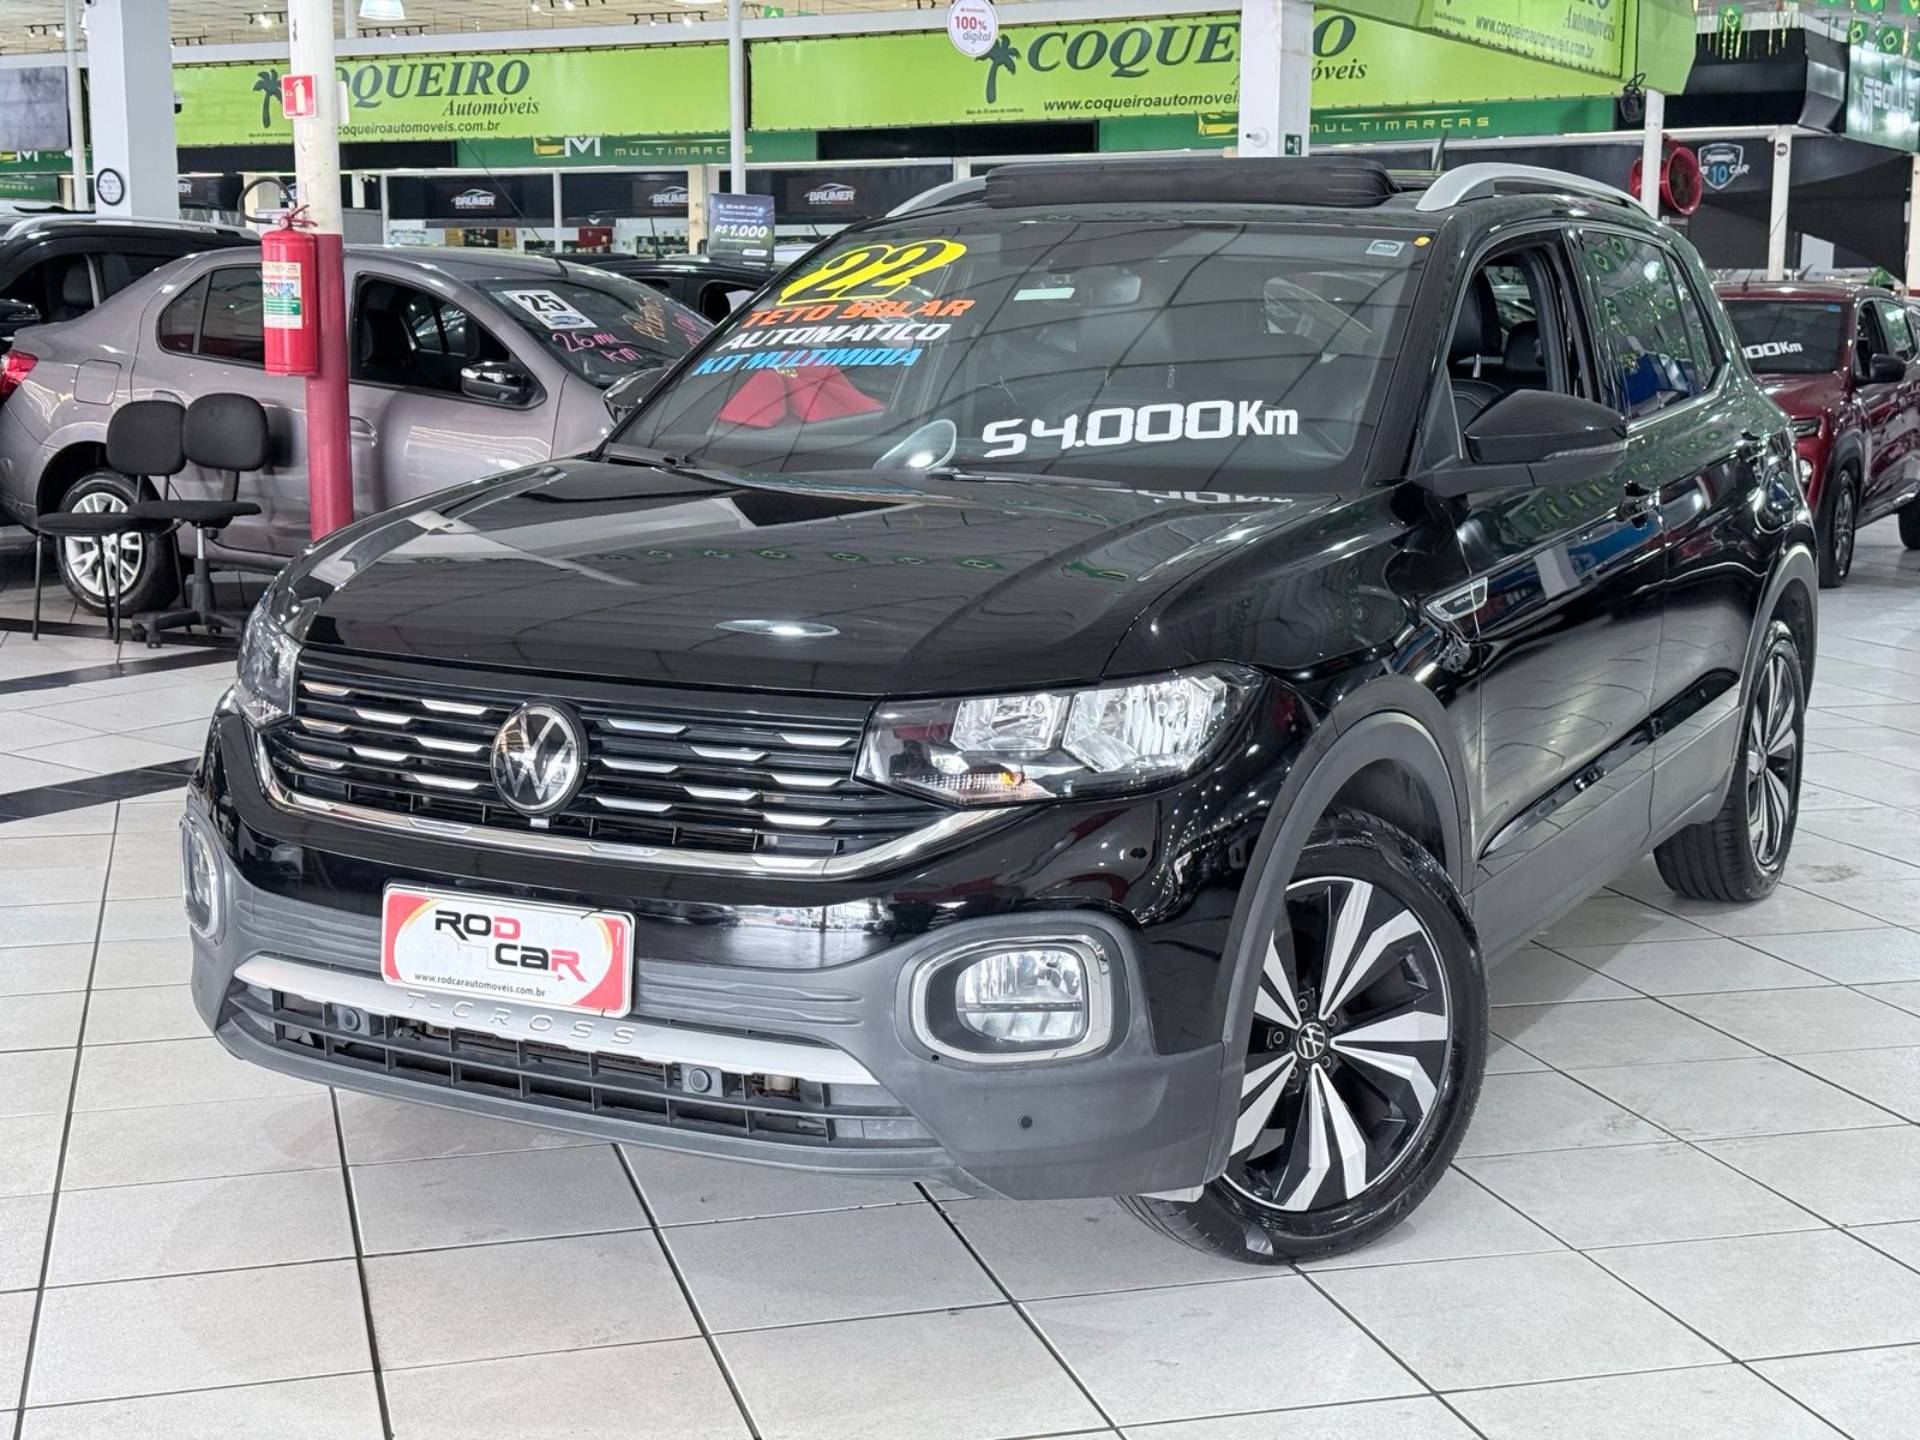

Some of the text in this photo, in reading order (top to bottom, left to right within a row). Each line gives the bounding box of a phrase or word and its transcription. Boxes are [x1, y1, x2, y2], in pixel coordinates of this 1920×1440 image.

[955, 16, 987, 31] 100%
[963, 31, 992, 44] digital
[335, 60, 530, 108] QUEIRO
[442, 97, 540, 117] Automóveis
[1043, 91, 1240, 112] www.coqueiroautomovei
[337, 120, 500, 136] coqueiroautomoveis.com.br
[614, 145, 753, 157] MULTIMARCS
[1711, 164, 1728, 183] 10
[653, 193, 689, 204] BRUME
[809, 190, 855, 201] BRUMER
[729, 223, 768, 238] 1.000
[776, 238, 967, 306] 22
[519, 293, 567, 313] 25
[741, 299, 976, 329] TETO SOLAR
[552, 332, 595, 353] 26
[692, 351, 749, 377] KIT
[435, 909, 521, 942] ROD
[414, 972, 546, 997] www.rodcarautomoveis.com.br
[406, 992, 637, 1045] T-CROSS
